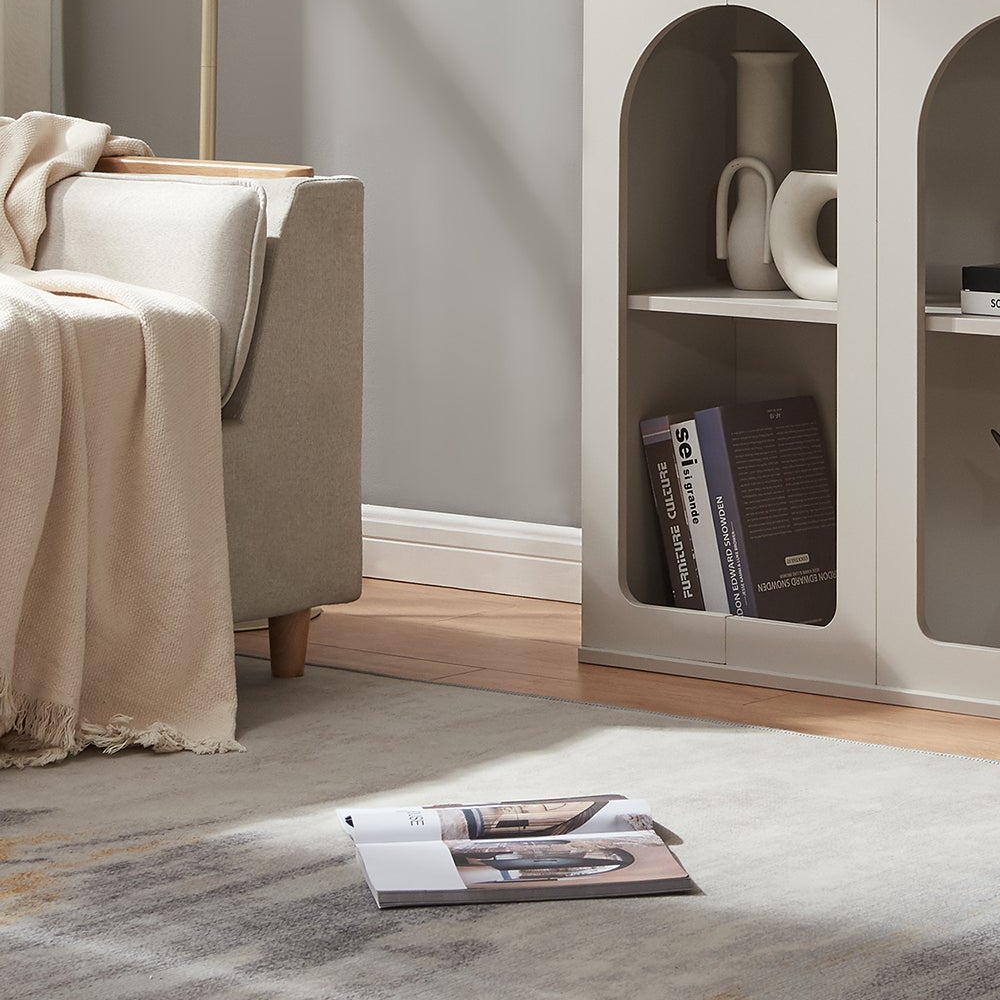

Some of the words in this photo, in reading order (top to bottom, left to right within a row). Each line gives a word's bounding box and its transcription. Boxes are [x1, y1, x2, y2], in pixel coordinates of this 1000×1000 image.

[675, 427, 698, 467] sei
[657, 461, 676, 520] CULTURE
[683, 468, 693, 480] si
[683, 482, 701, 525] grande
[715, 495, 731, 546] SNOWDEN
[670, 525, 693, 599] FURNITURE
[724, 548, 739, 591] EDWARD
[791, 574, 817, 587] EDWARD
[757, 578, 791, 593] SNOWDEN
